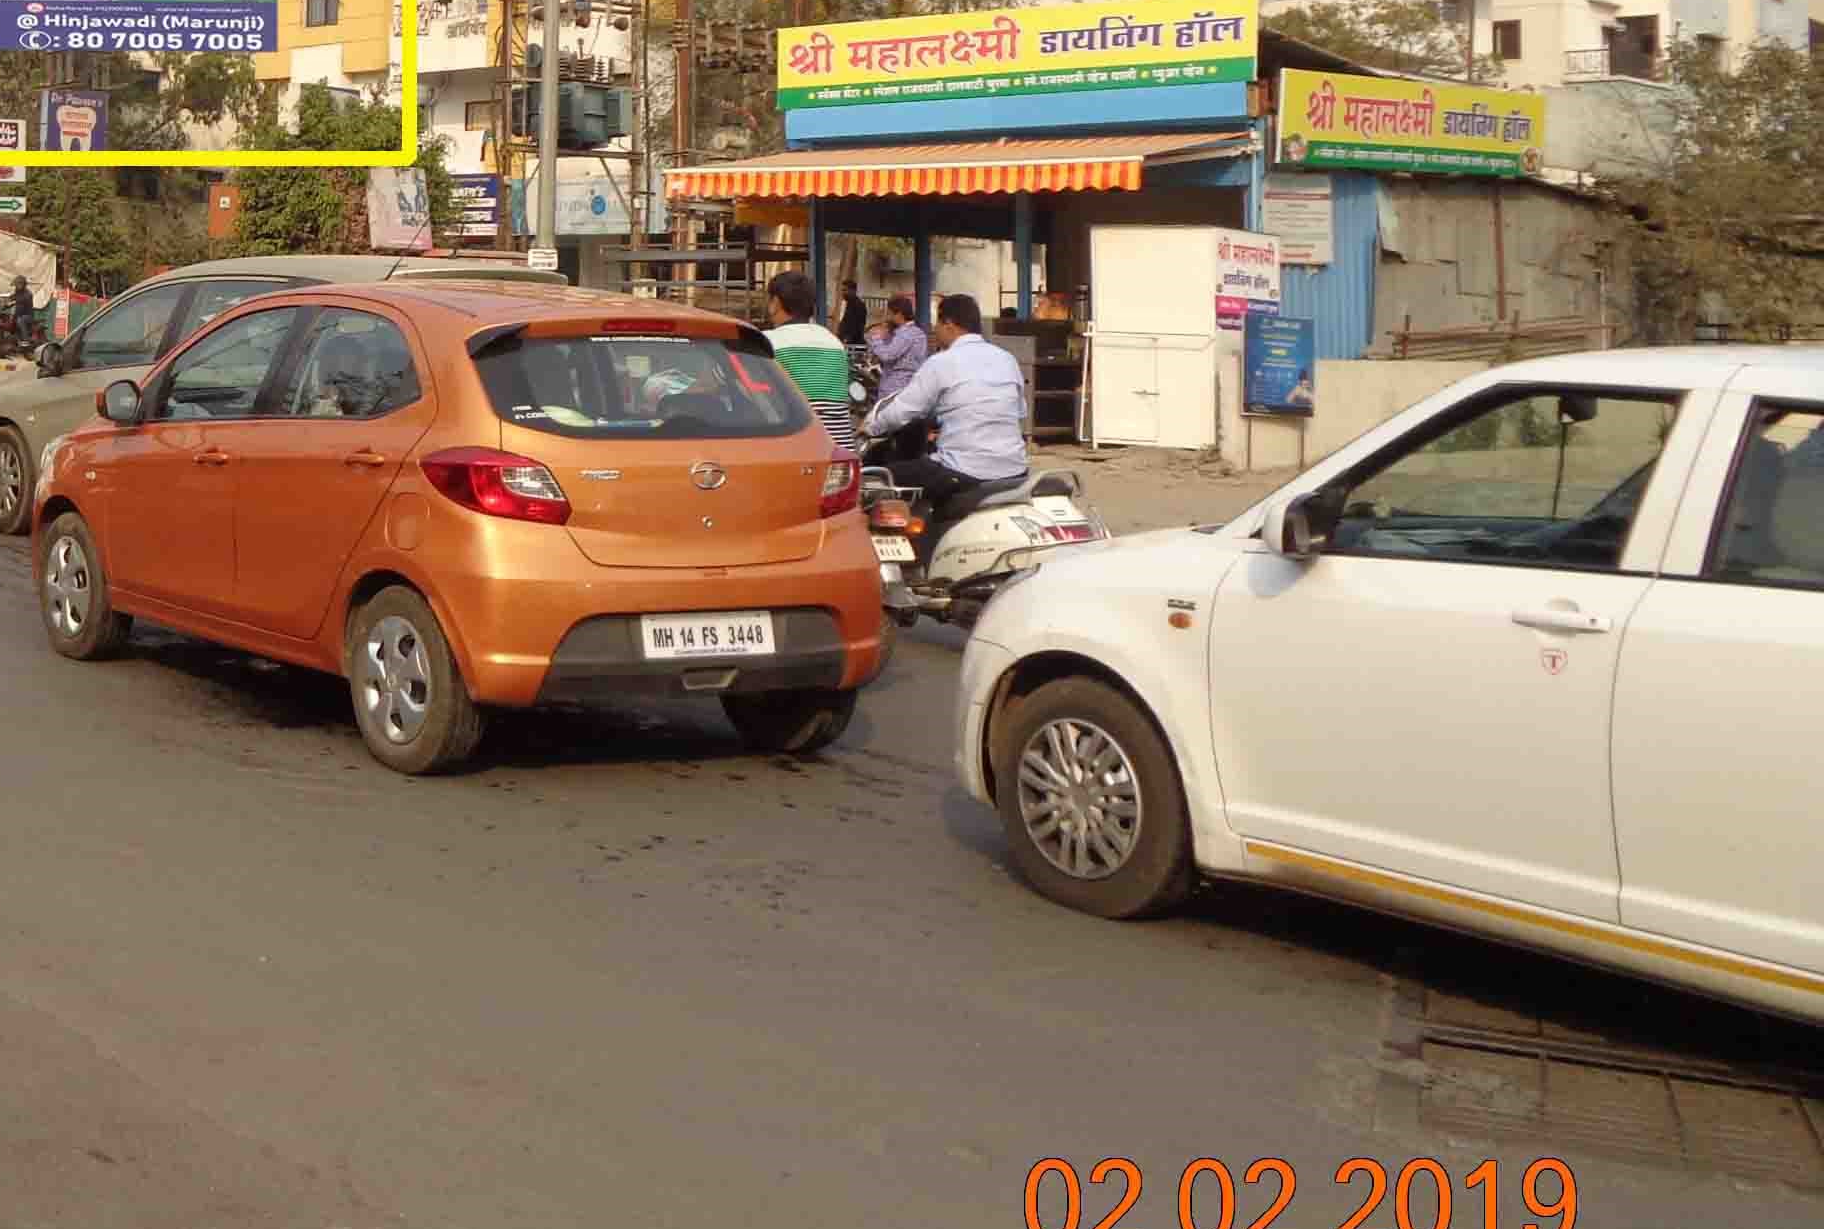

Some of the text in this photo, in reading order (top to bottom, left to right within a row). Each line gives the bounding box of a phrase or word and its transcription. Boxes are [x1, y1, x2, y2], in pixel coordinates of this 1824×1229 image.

[16, 14, 265, 31] @ Hinjawadi (Marunji)
[111, 32, 183, 49] 7005
[190, 32, 263, 49] 7005
[788, 11, 1245, 75] श्री महालक्ष्मी डायनिंग हॉल
[1306, 79, 1531, 143] श्री महालक्ष्मी डायनिंग हॉल
[653, 624, 764, 648] MH 14 FS 3448
